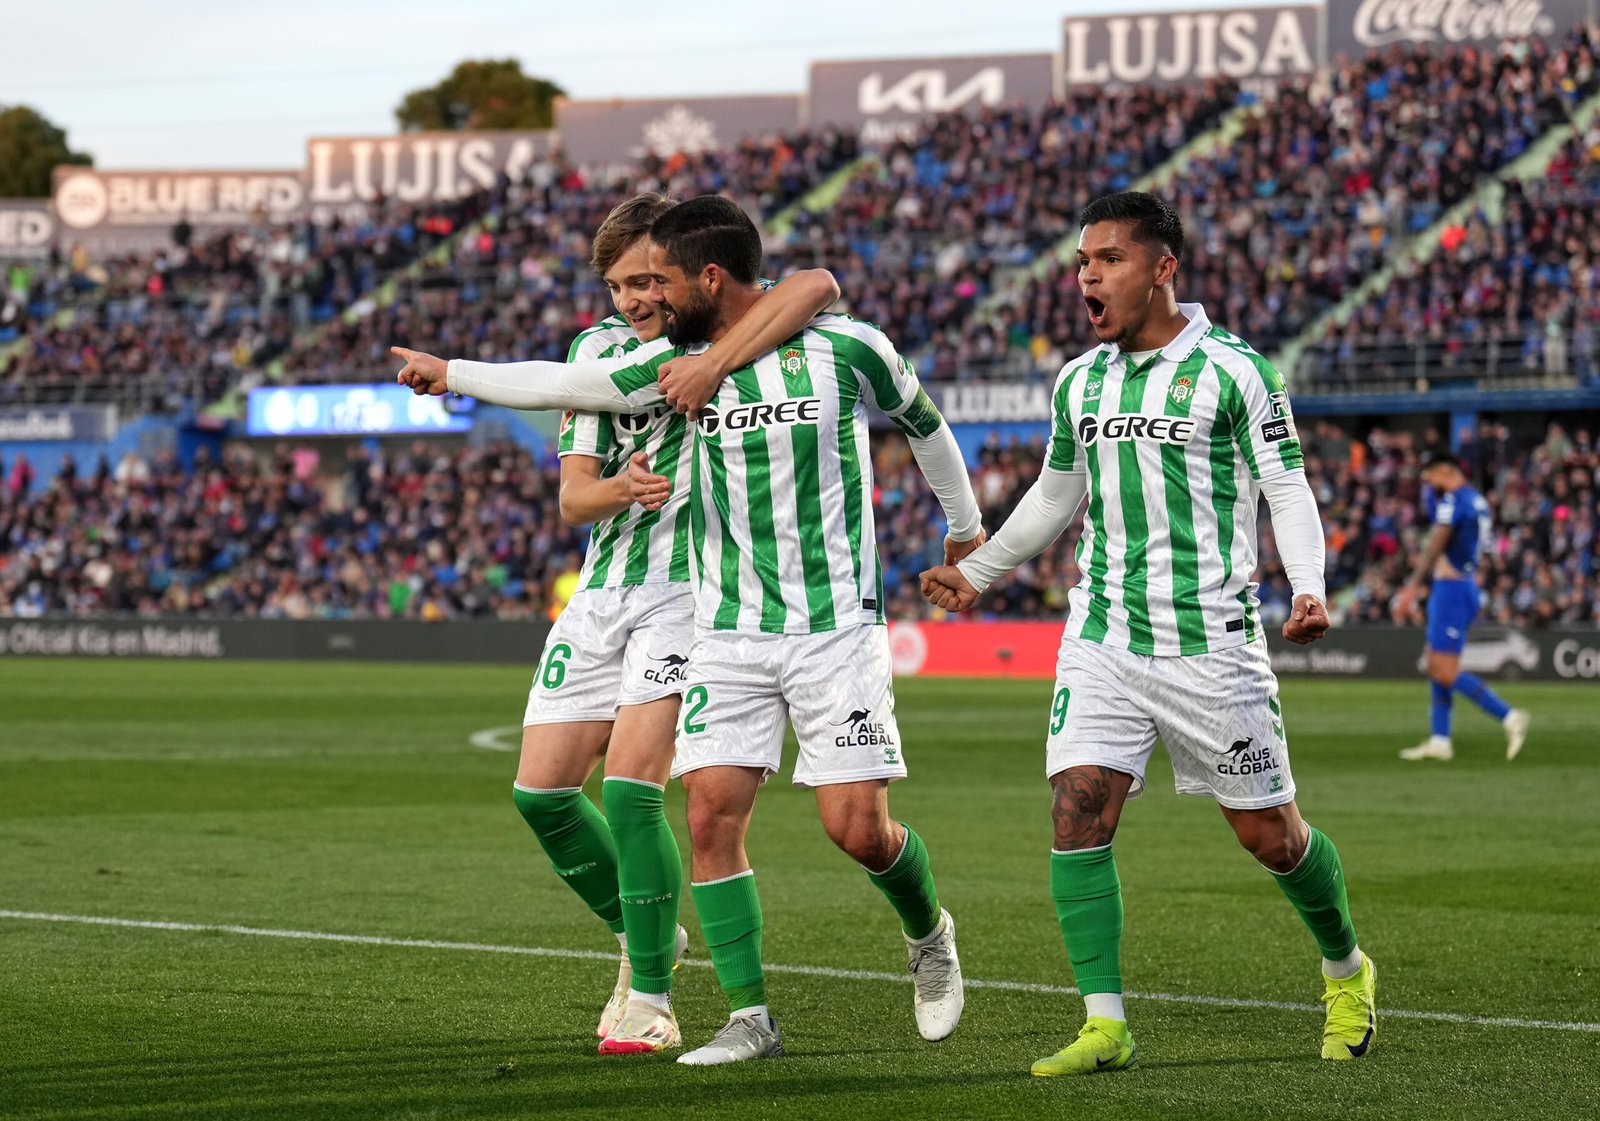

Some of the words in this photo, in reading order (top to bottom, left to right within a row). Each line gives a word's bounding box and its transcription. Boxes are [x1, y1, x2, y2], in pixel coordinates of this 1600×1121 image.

[1066, 10, 1313, 83] LUJISA
[857, 67, 1005, 114] KIA
[109, 176, 212, 214] BLUE
[725, 399, 821, 430] GREE
[1102, 416, 1195, 442] GREE
[1050, 687, 1071, 736] 9
[835, 734, 895, 747] GLOBAL
[858, 723, 885, 734] AUS
[1217, 757, 1280, 775] GLOBAL
[1240, 747, 1270, 764] AUS
